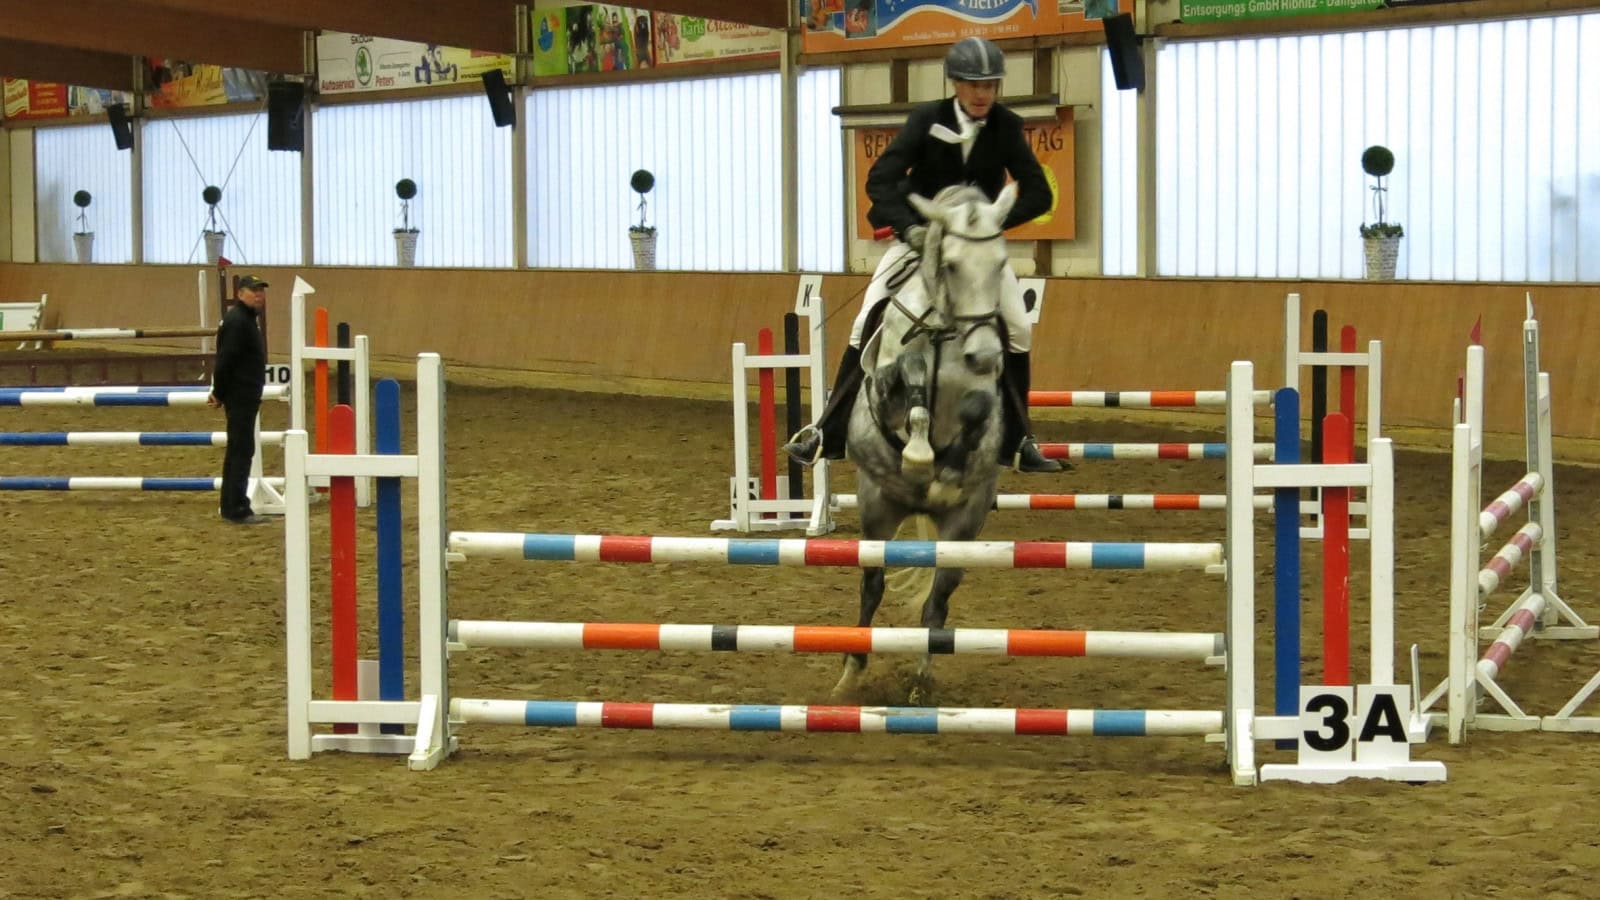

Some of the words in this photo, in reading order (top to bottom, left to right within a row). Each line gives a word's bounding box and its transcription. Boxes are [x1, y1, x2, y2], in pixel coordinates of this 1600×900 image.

[1184, 3, 1246, 18] Entsorgungs
[1249, 0, 1279, 13] GmbH
[863, 134, 891, 159] BE
[1023, 126, 1064, 152] TAG
[803, 283, 813, 308] K
[265, 366, 291, 384] 10
